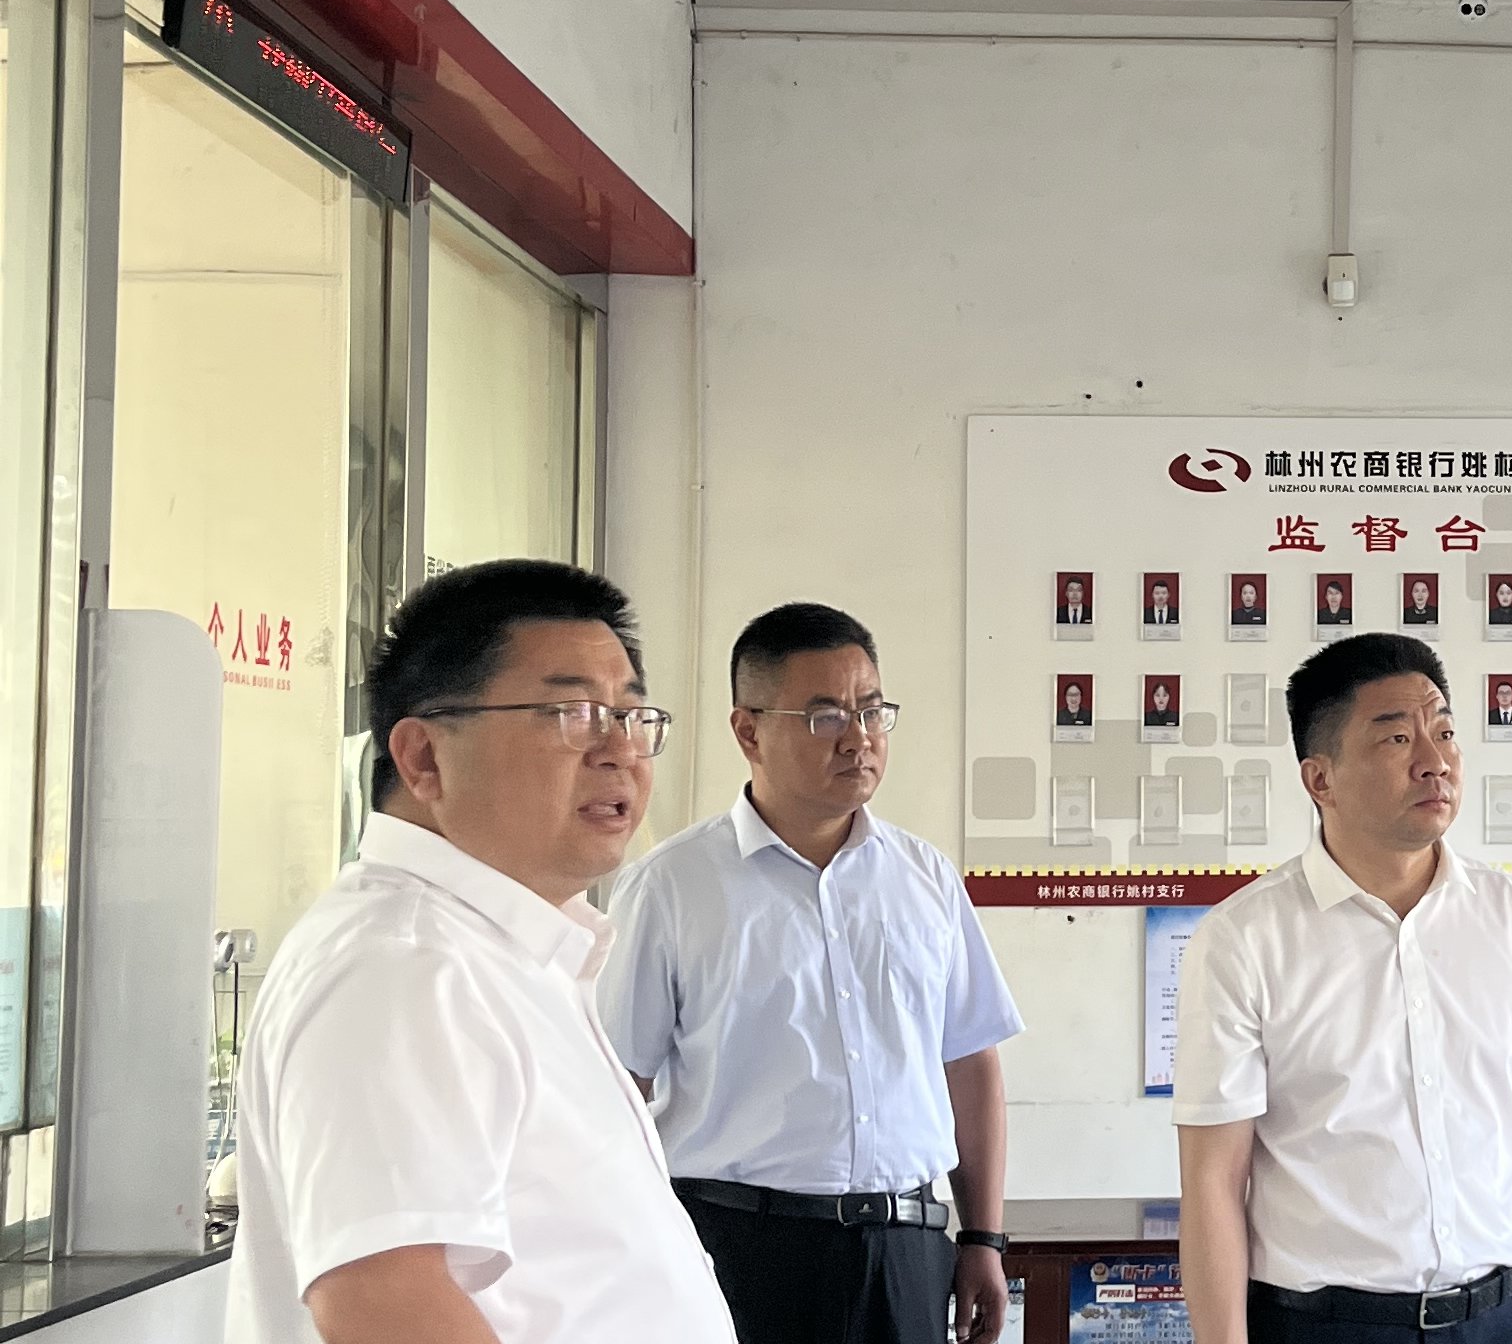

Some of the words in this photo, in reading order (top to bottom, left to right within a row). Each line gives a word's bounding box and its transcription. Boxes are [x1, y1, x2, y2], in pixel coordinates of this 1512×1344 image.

[1268, 484, 1316, 494] LINZHOU
[1320, 484, 1355, 494] RURAL
[1358, 484, 1430, 494] COMMERCIAL
[1433, 484, 1463, 494] BANK
[1466, 484, 1512, 494] YAOCUN
[1268, 514, 1487, 552] 监督台
[208, 601, 292, 671] 个人业务
[1037, 884, 1185, 899] 林州农商银行姚村支行
